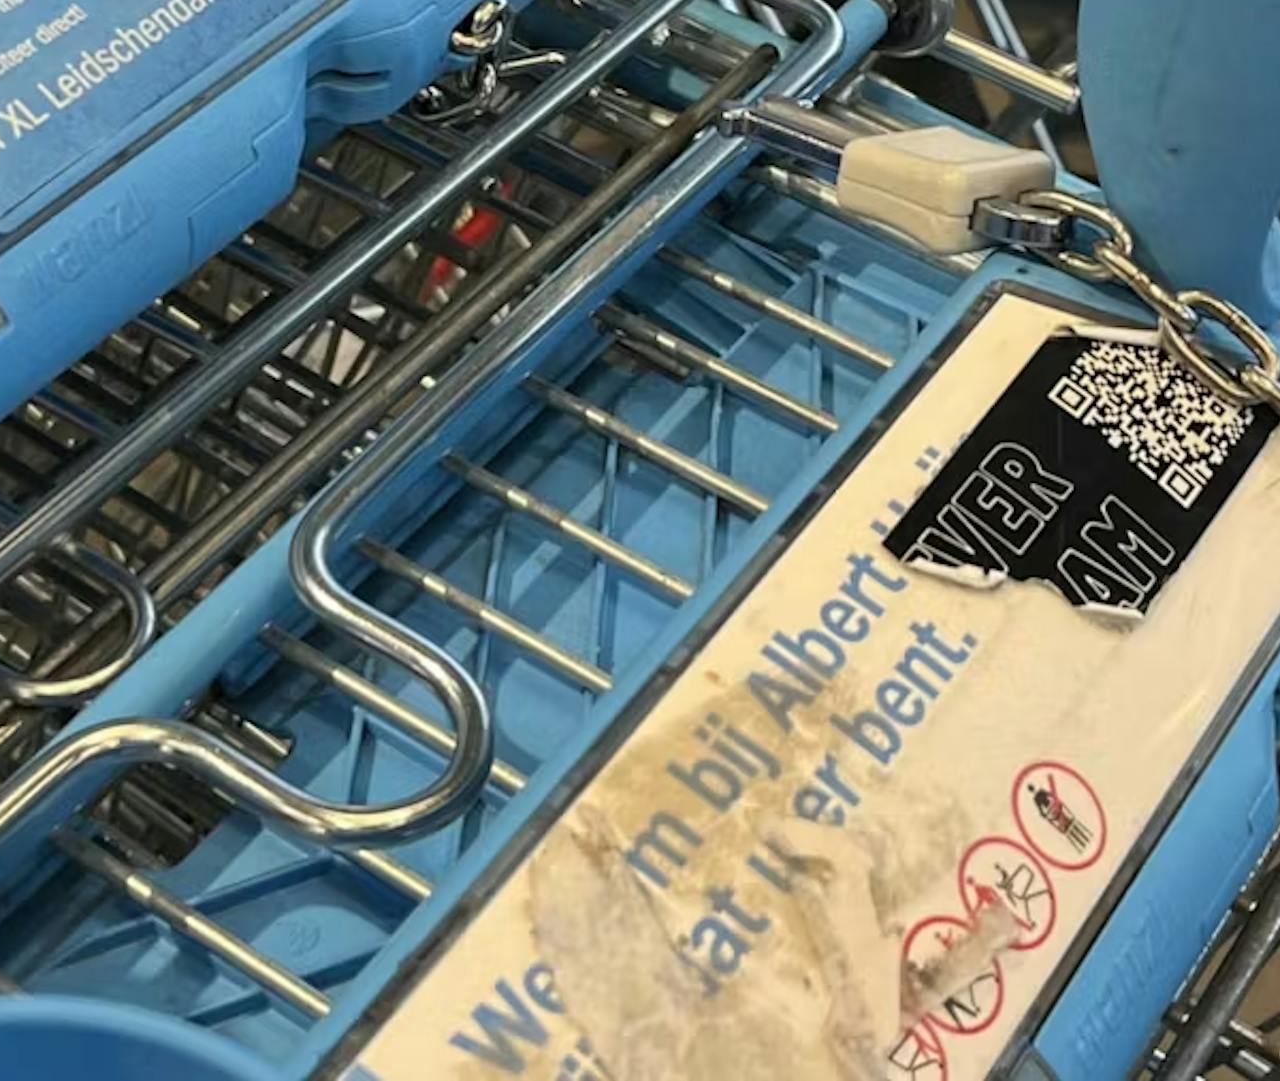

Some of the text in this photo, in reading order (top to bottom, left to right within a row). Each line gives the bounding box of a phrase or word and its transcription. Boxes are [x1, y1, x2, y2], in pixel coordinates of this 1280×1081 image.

[900, 442, 1075, 576] VER
[666, 710, 783, 814] bij
[747, 553, 910, 733] Albert
[792, 751, 861, 828] er
[829, 620, 979, 766] bent.
